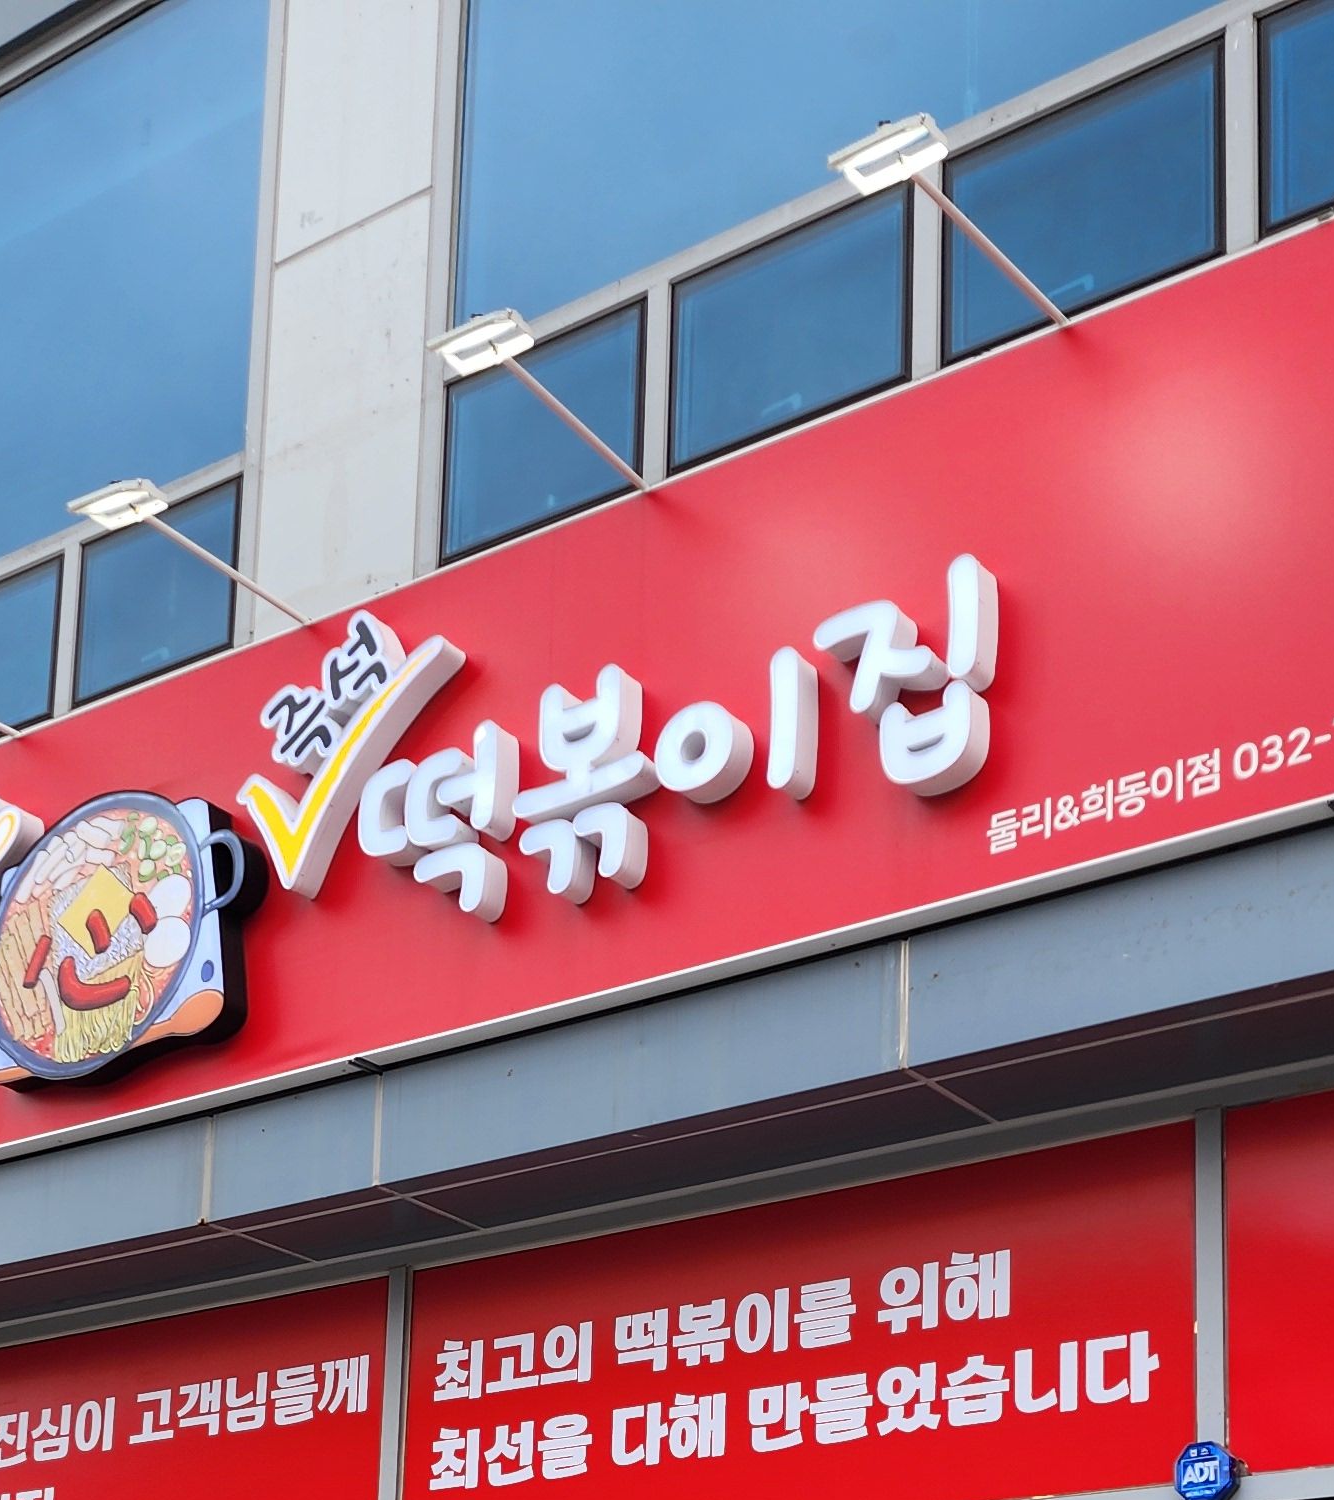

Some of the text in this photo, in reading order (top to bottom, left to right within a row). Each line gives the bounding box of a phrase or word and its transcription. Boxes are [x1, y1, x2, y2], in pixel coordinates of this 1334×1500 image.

[265, 609, 403, 770] 즉석
[354, 552, 1001, 925] 떡볶이집
[984, 750, 1225, 856] 둘리&희동이점
[129, 1350, 371, 1446] 고객님들께
[432, 1246, 1014, 1404] 최고의 떡볶이를 위해
[429, 1329, 1161, 1494] 최선을 다해 만들었습니다
[1182, 1460, 1219, 1486] ADT
